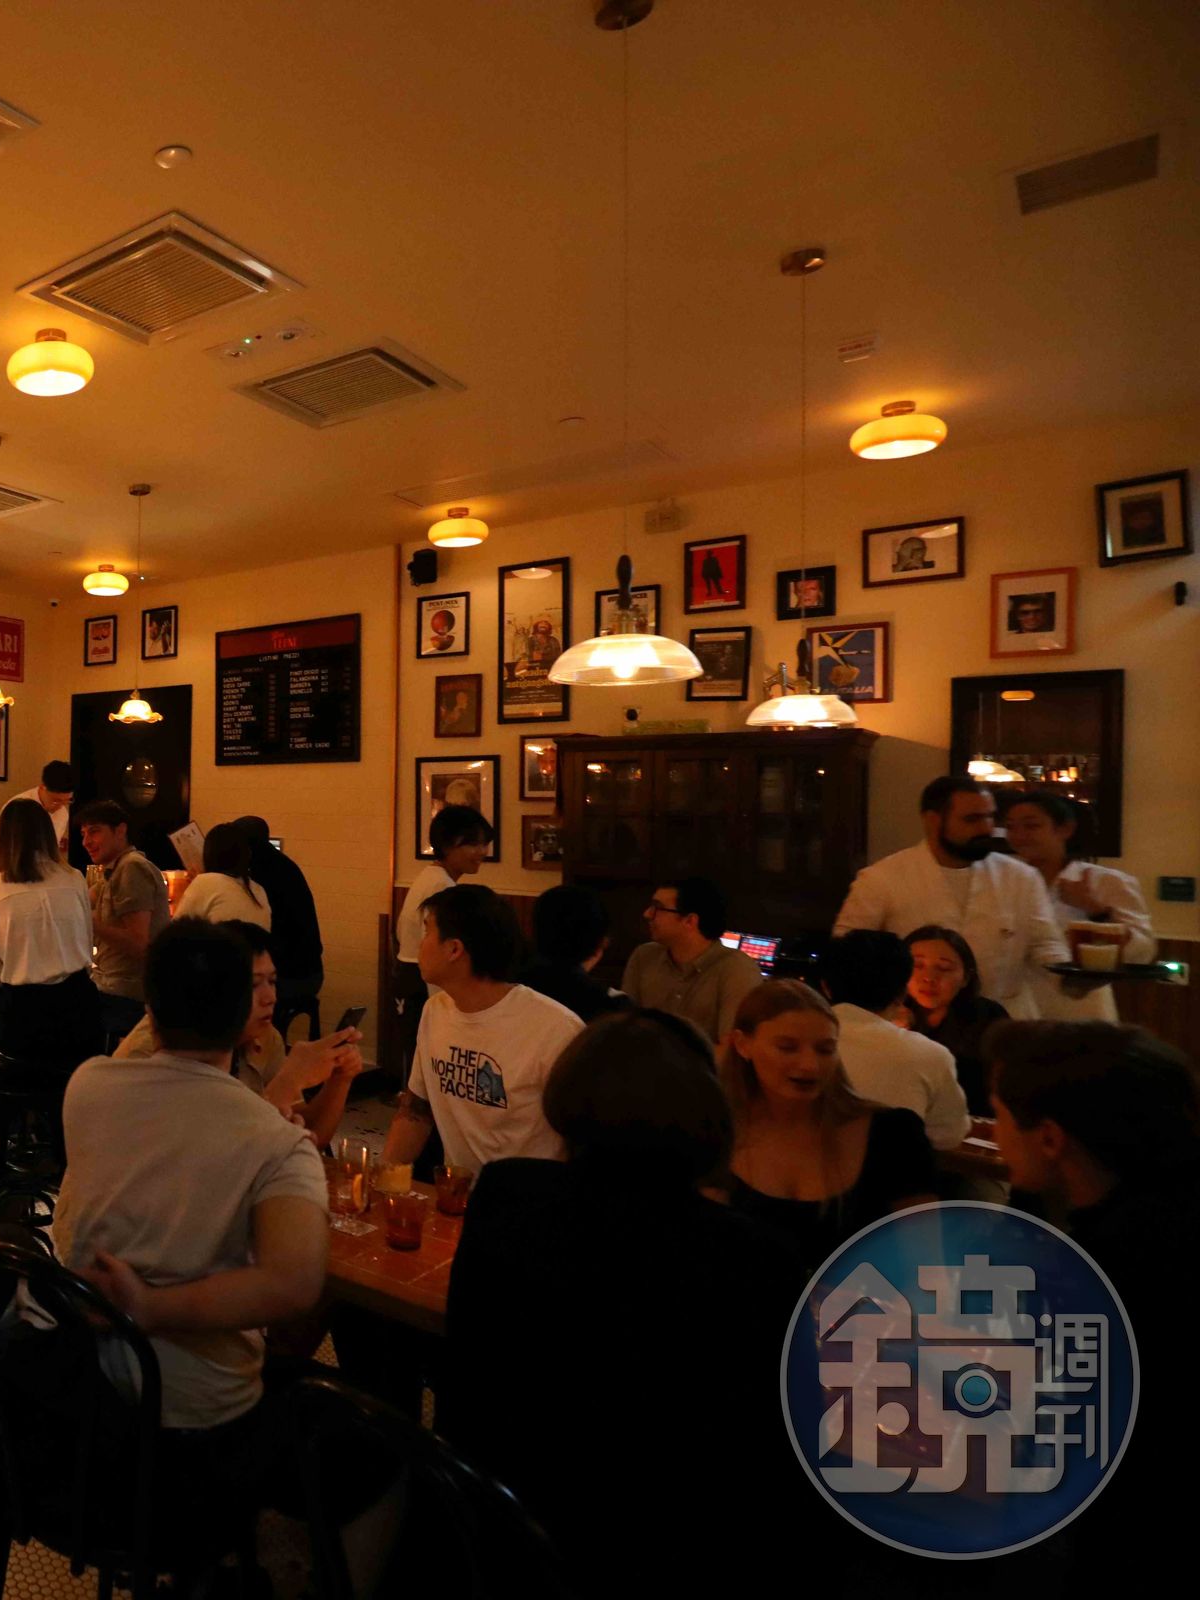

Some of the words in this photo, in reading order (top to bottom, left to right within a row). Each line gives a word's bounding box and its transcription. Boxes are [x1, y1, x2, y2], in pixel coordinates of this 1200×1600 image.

[449, 1046, 478, 1067] THE
[431, 1057, 476, 1085] NORTH
[439, 1077, 475, 1102] FACE
